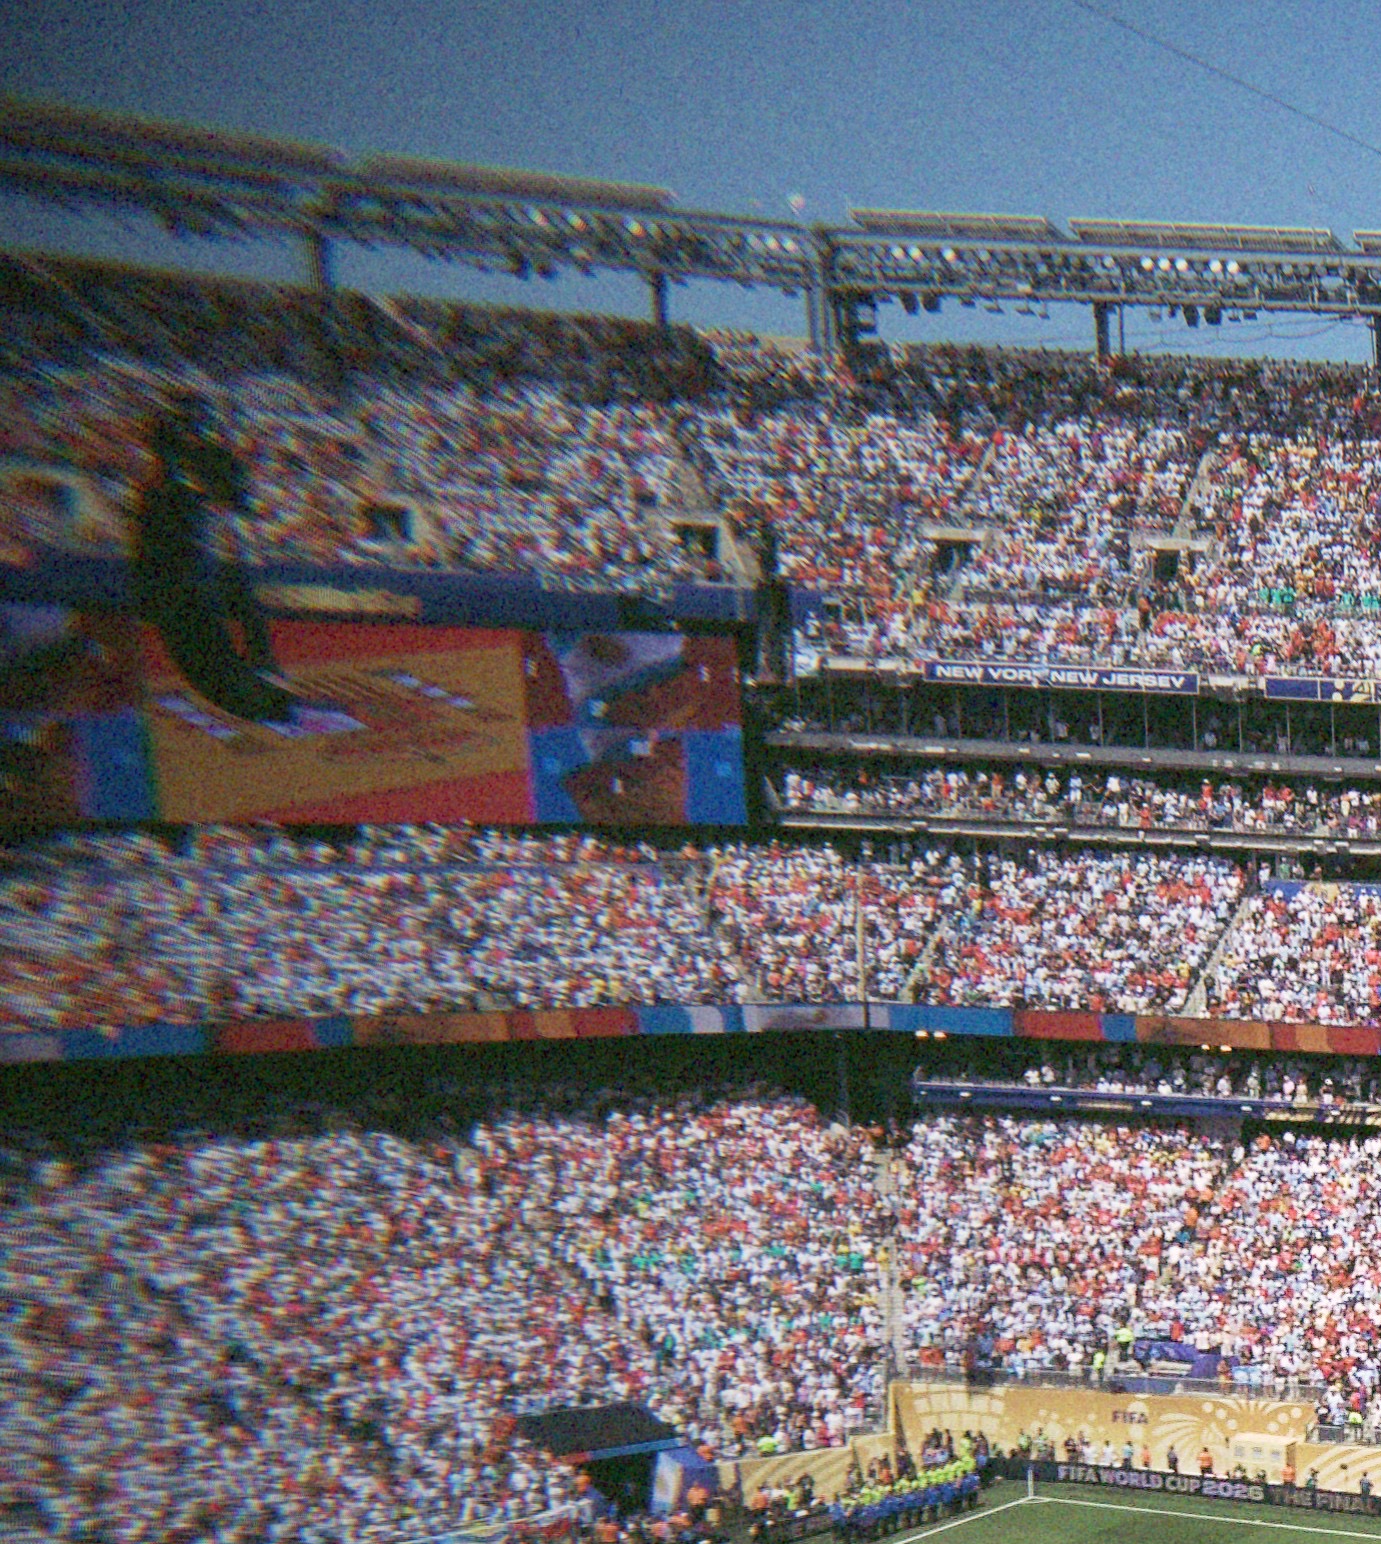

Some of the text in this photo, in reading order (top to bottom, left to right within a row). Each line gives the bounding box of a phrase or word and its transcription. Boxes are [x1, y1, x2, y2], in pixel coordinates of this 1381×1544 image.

[934, 664, 1186, 689] NEW YOR NEW JERSEY
[1112, 1409, 1149, 1425] FIFA
[1057, 1465, 1099, 1484] FIFA
[1099, 1468, 1163, 1490] WORLD
[1165, 1474, 1201, 1493] CUP
[1201, 1479, 1265, 1501] 2026
